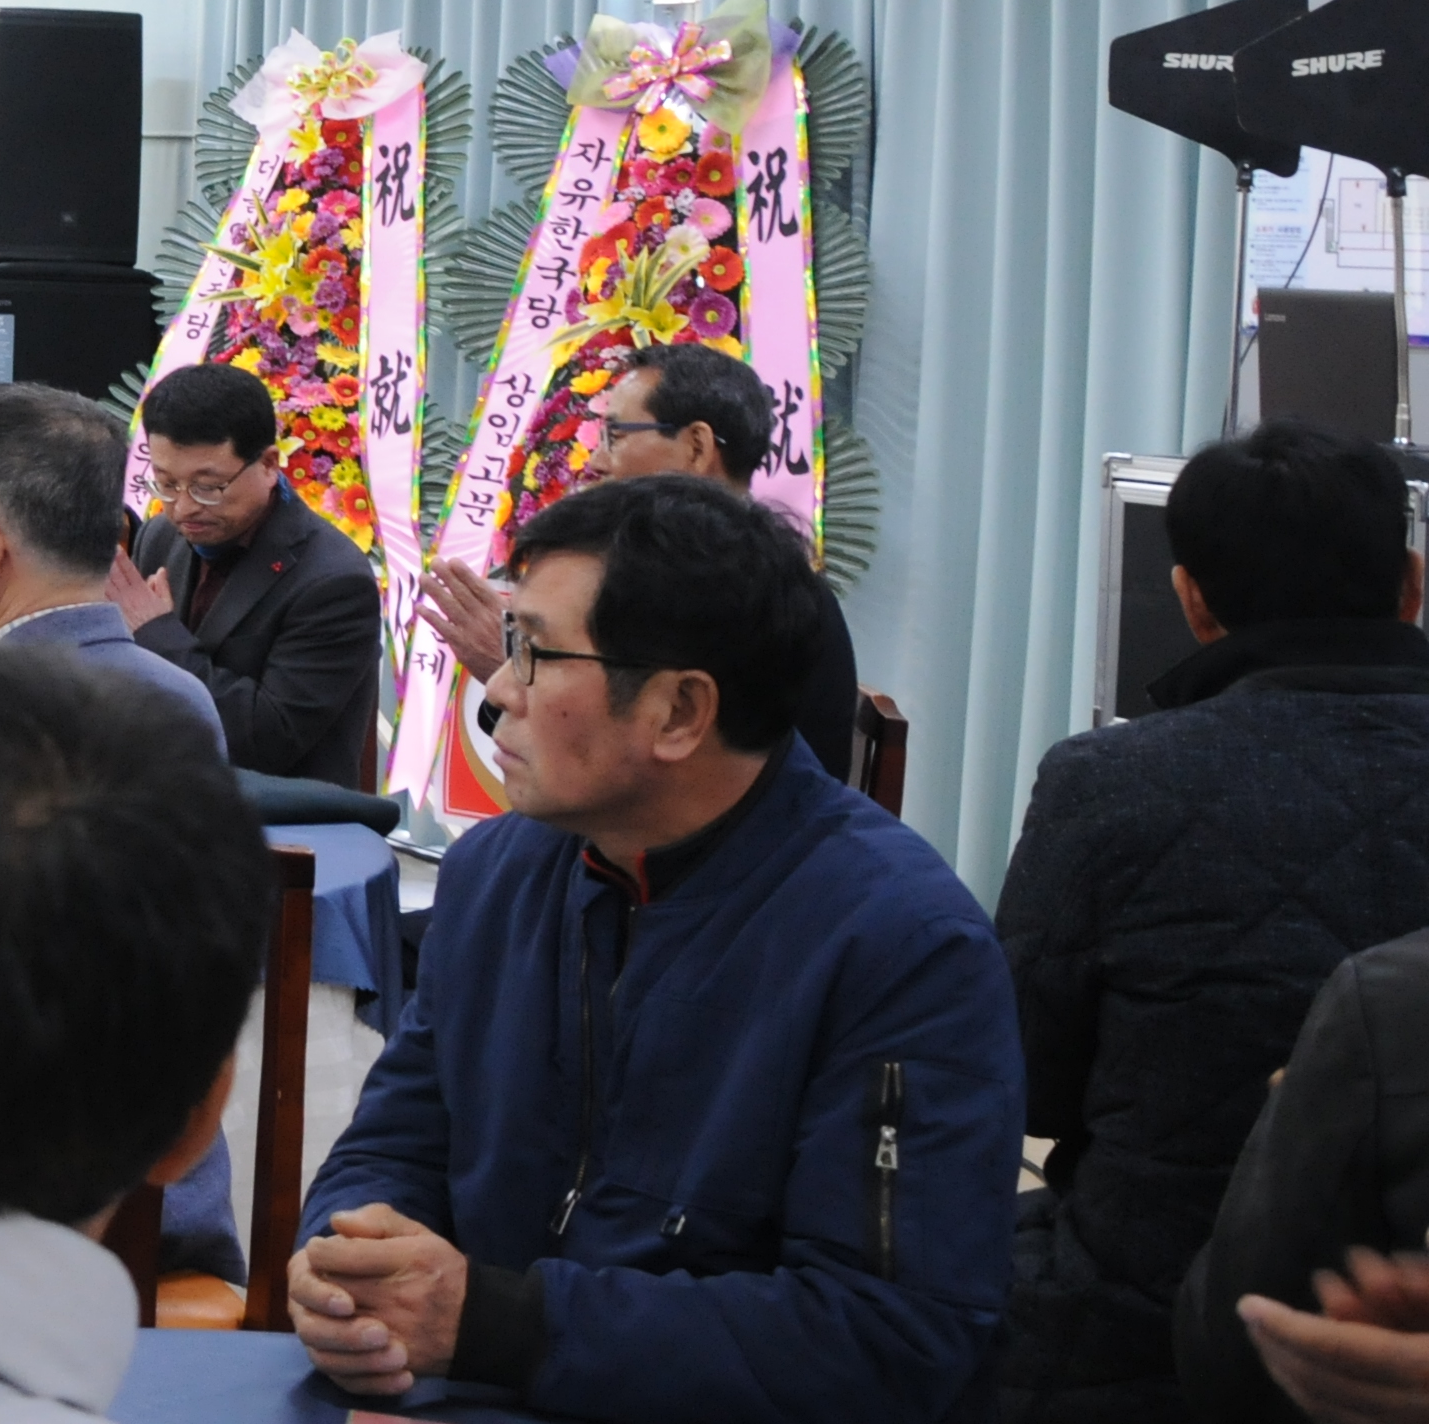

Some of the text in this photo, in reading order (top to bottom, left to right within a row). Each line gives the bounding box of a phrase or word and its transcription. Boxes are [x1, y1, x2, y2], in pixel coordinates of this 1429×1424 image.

[1163, 52, 1234, 72] SHUR
[1291, 49, 1384, 77] SHURE
[527, 137, 612, 329] 자유한국당
